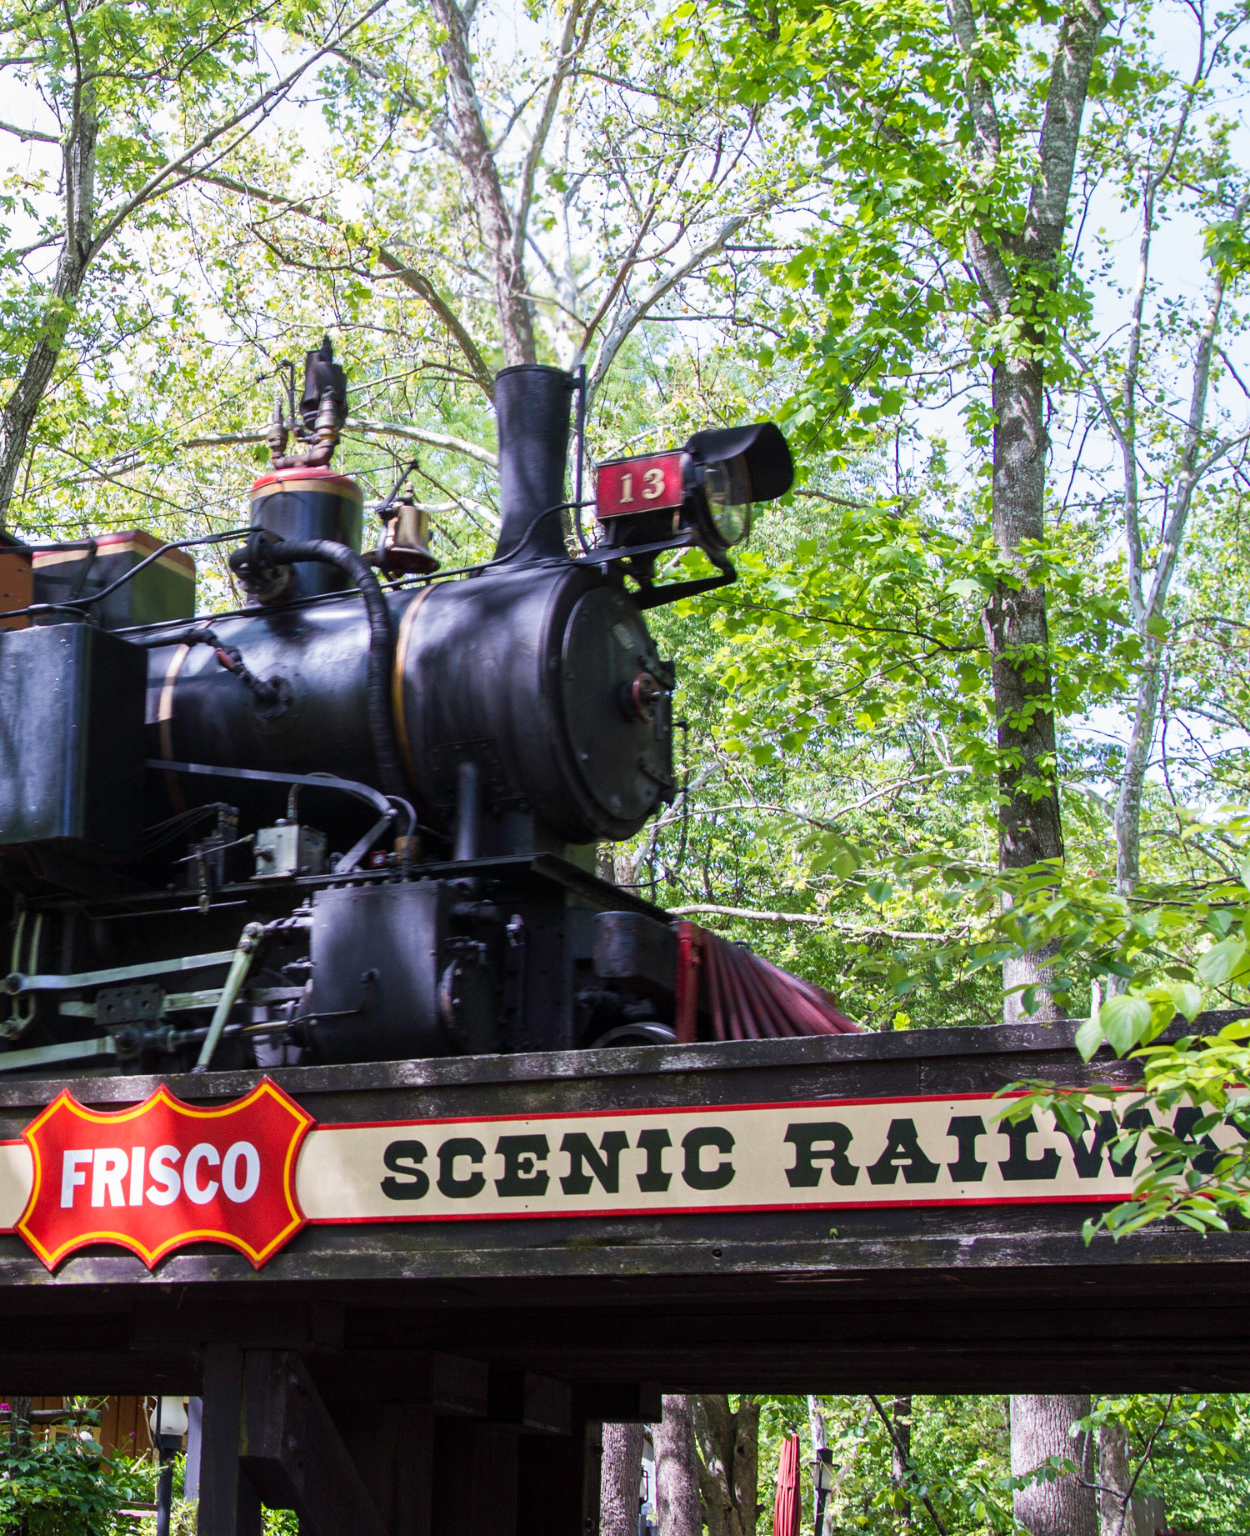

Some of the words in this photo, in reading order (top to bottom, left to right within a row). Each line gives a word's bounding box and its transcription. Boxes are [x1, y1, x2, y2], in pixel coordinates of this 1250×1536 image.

[619, 467, 666, 504] 13
[60, 1140, 261, 1209] FRISCO
[380, 1125, 737, 1201] SCENIC
